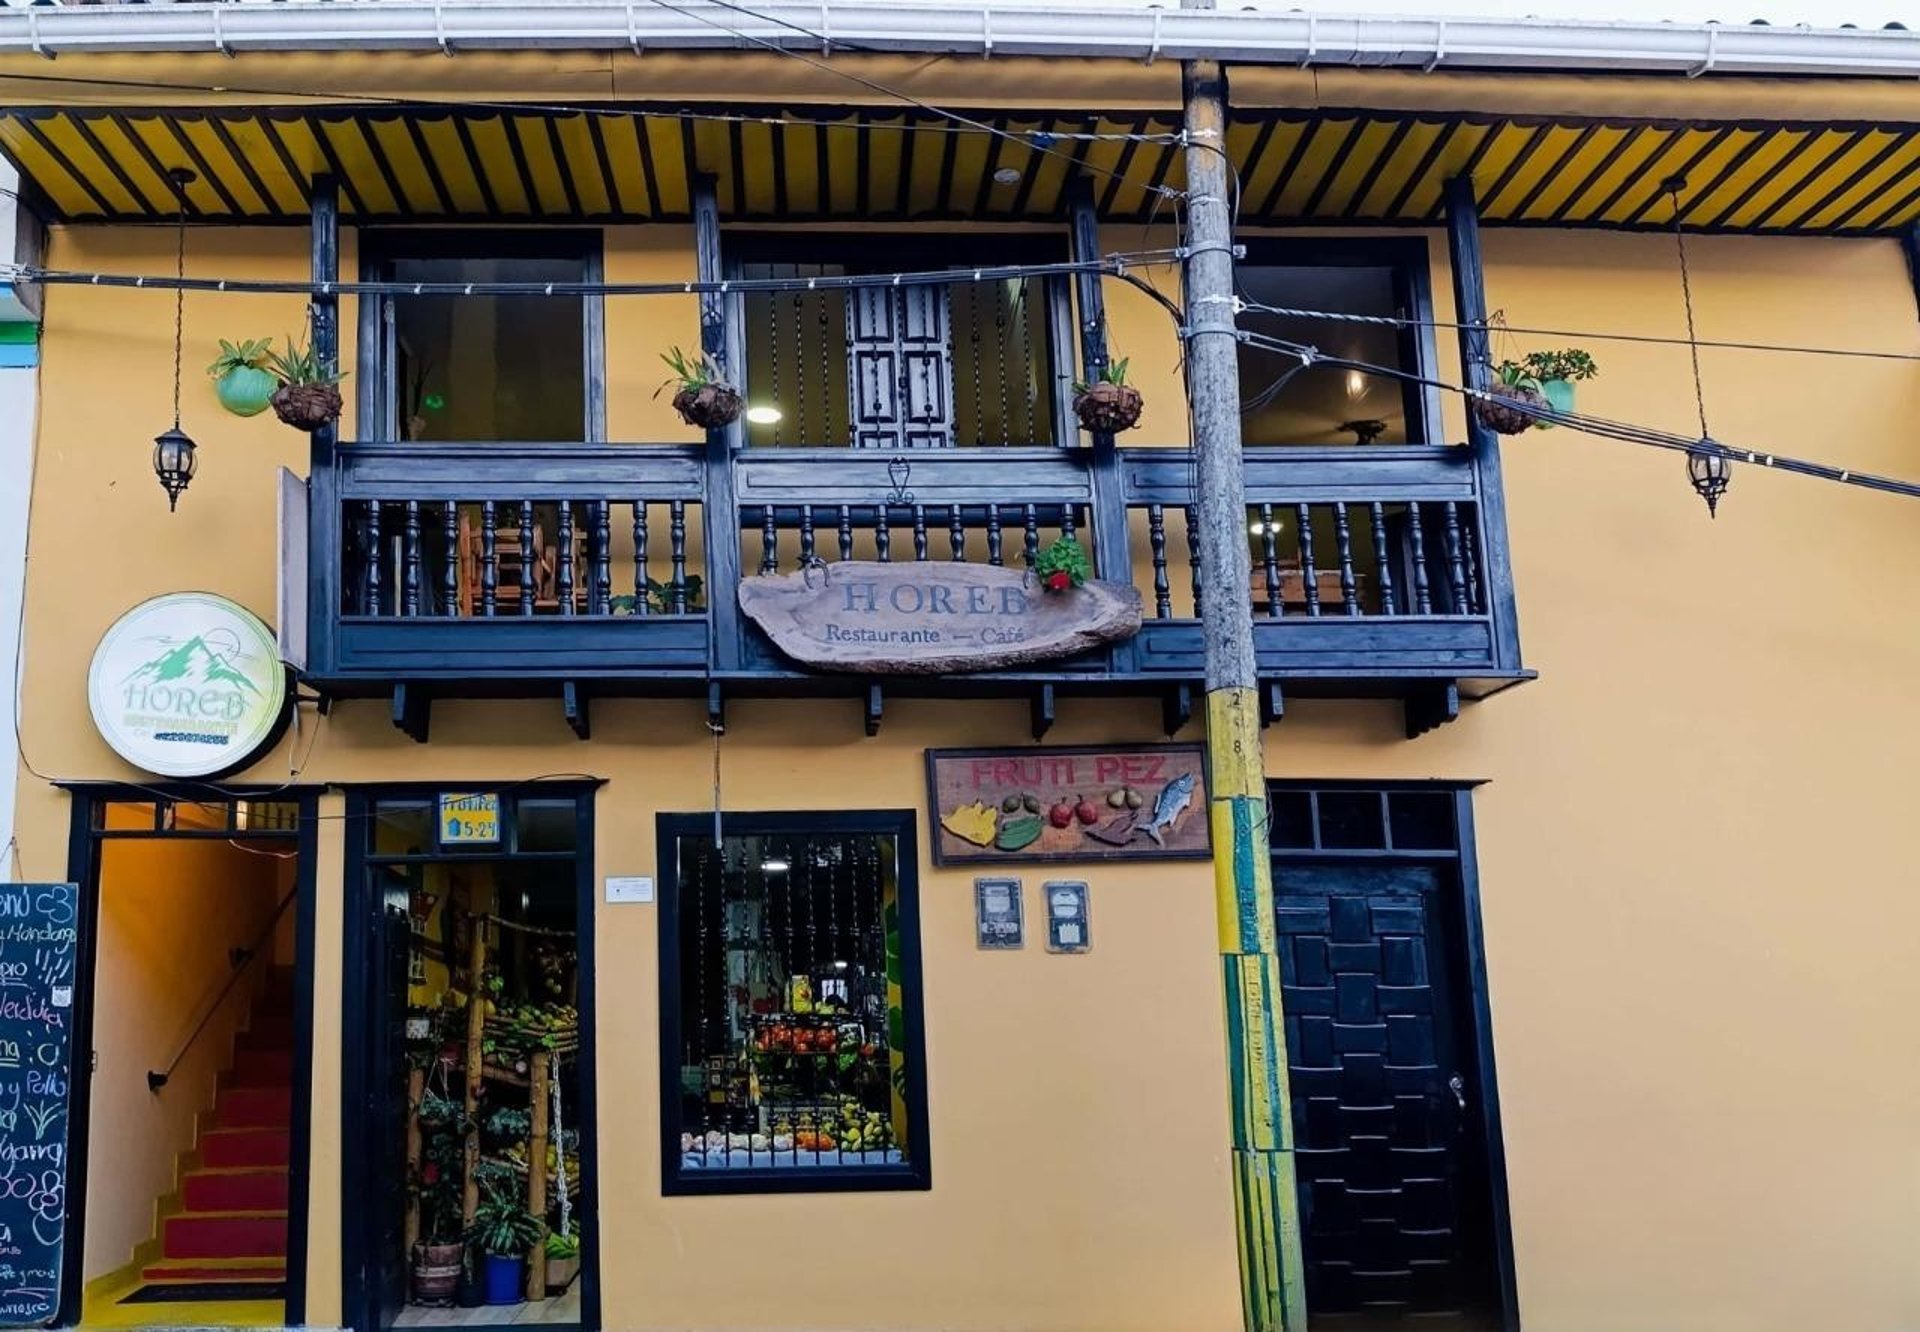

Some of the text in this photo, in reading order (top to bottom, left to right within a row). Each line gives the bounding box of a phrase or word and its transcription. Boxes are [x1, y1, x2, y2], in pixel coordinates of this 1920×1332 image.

[839, 582, 1027, 615] HOREB
[825, 623, 940, 643] Restaurante
[980, 624, 1025, 645] Café
[971, 755, 1167, 788] FRUTI PEZ
